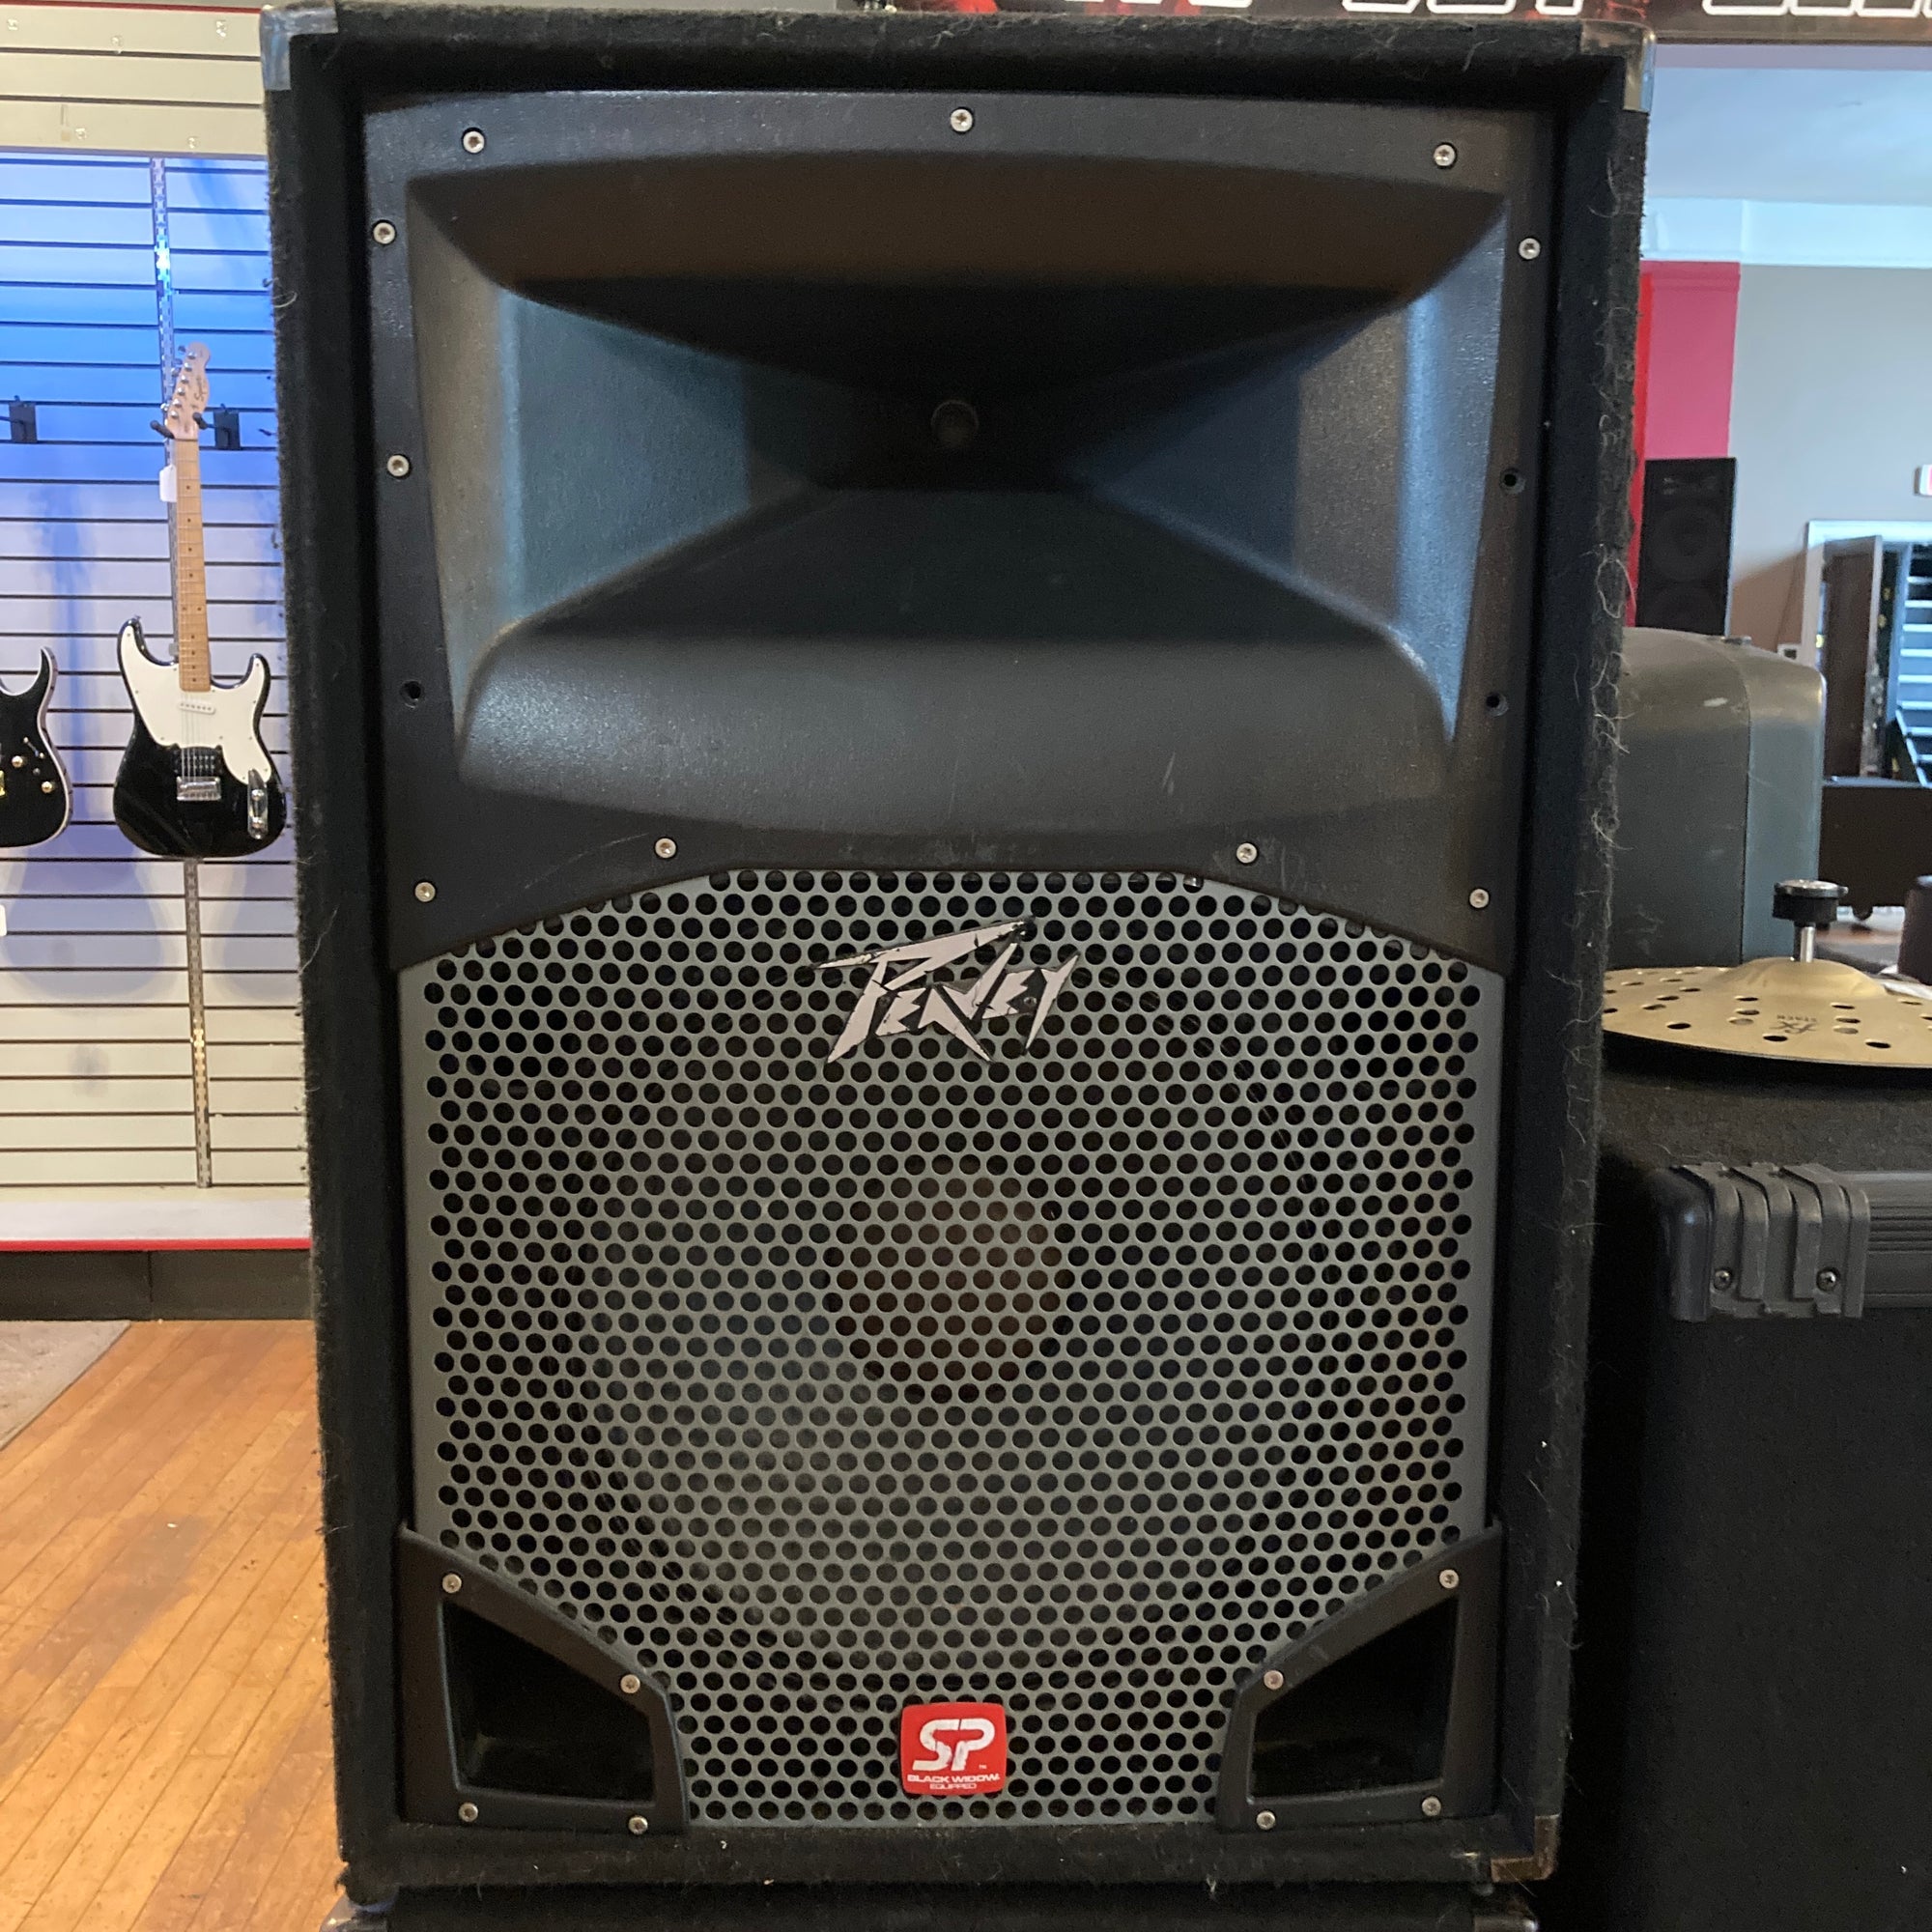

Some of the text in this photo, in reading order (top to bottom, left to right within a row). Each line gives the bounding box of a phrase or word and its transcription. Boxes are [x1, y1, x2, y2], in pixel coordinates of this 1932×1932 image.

[912, 1718, 995, 1772] SP
[907, 1773, 1000, 1783] BLACK WIDOW
